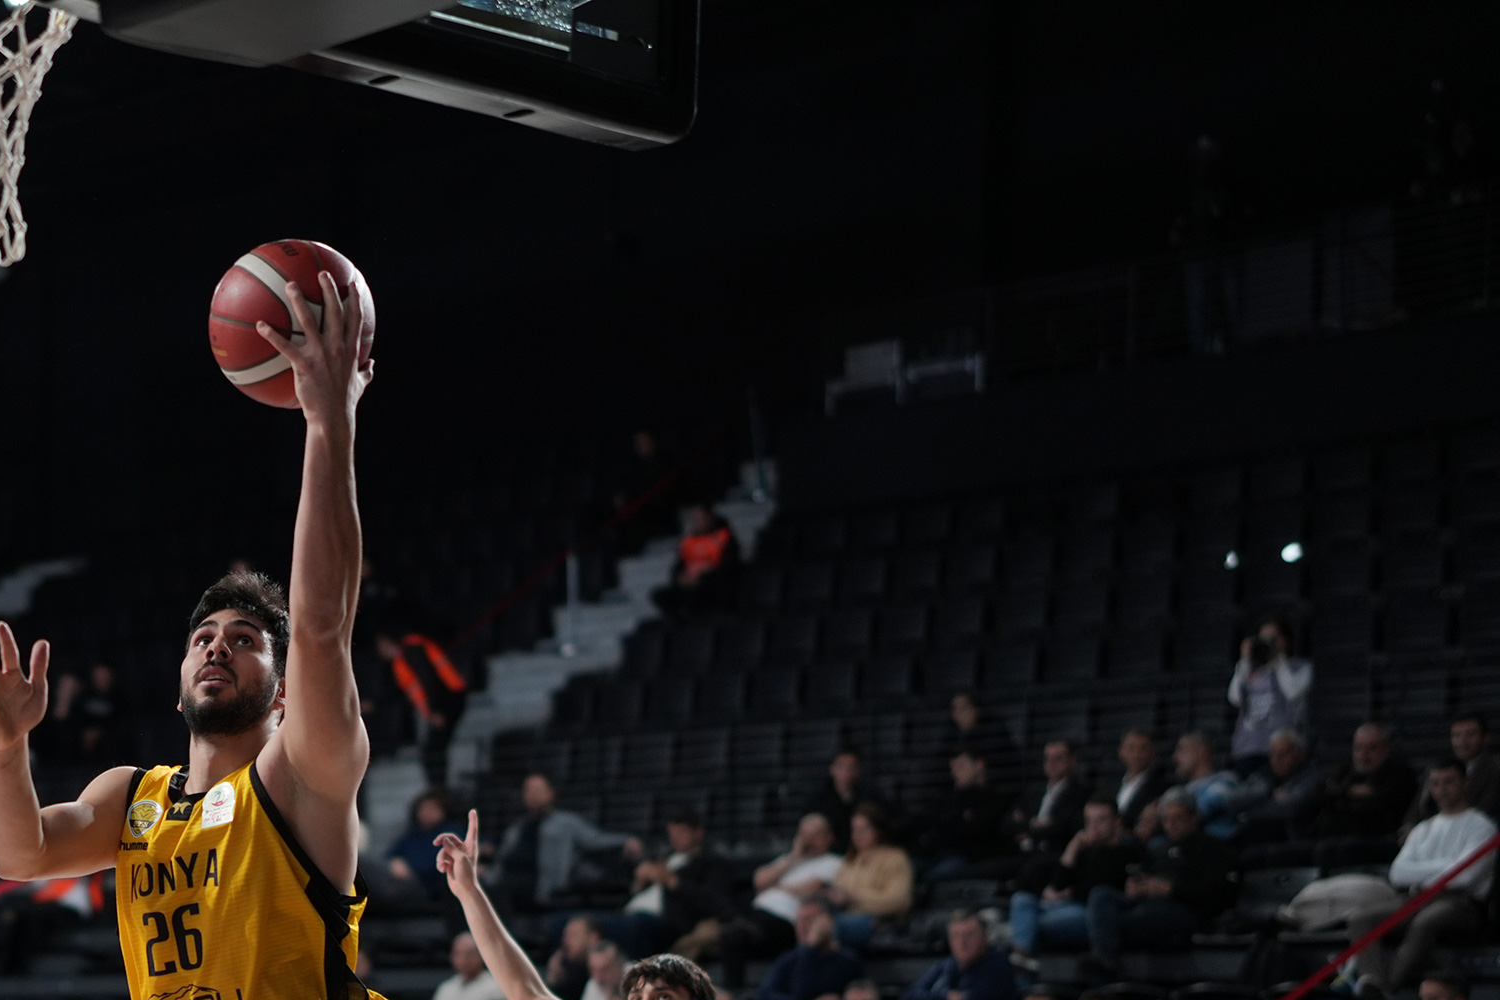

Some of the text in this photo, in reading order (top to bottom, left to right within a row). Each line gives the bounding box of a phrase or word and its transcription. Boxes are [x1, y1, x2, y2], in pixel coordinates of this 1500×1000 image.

[119, 840, 149, 851] humme
[131, 849, 219, 902] KONYA
[142, 902, 204, 977] 26
